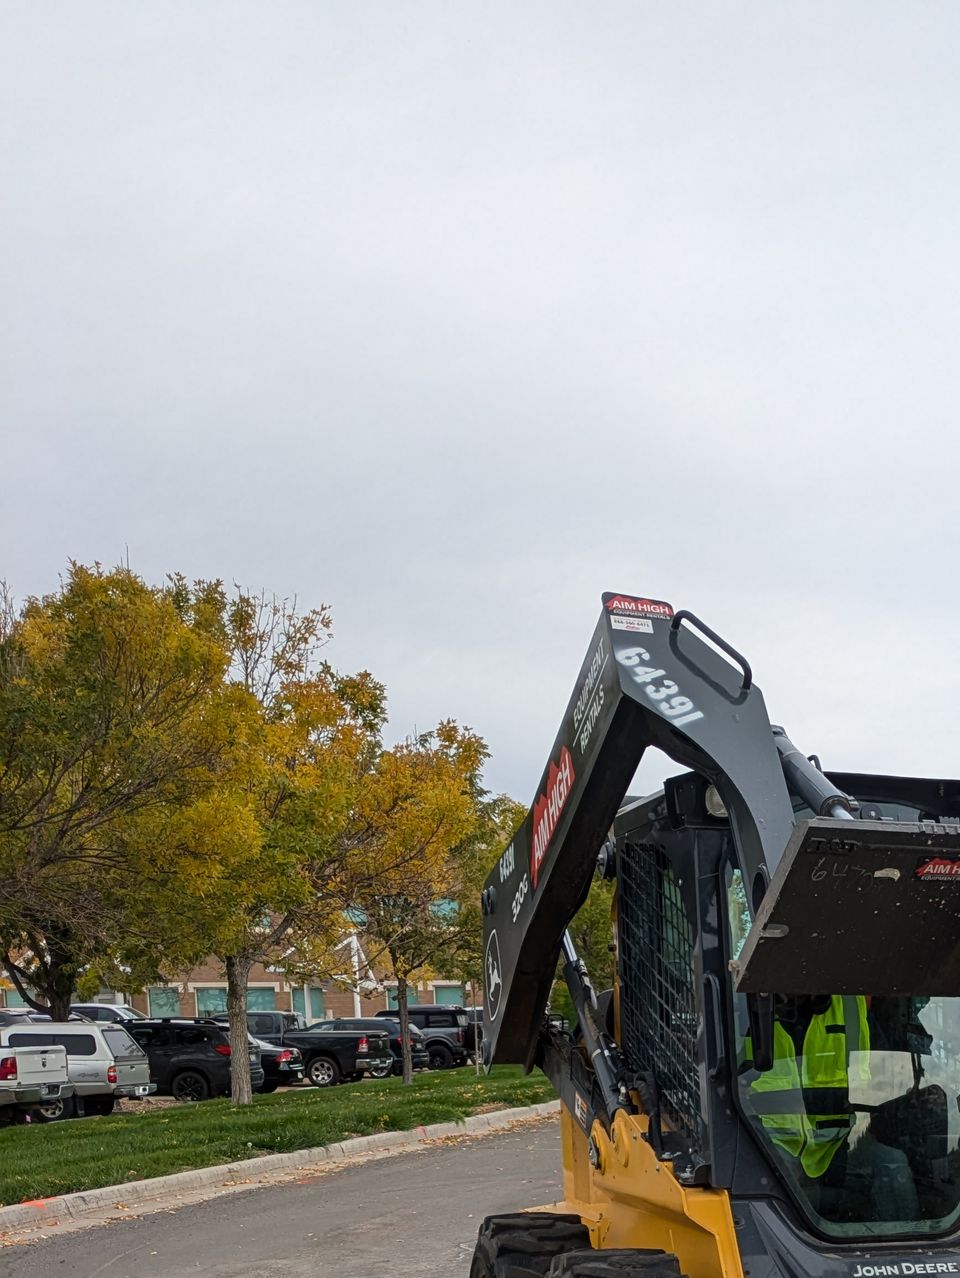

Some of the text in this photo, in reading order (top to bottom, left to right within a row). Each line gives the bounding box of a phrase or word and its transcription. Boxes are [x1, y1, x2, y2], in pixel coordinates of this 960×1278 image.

[613, 600, 669, 614] AIM HIGH
[573, 637, 604, 730] EQUIPMENT
[615, 647, 704, 727] 64391
[580, 684, 604, 754] RENTALS
[534, 751, 571, 870] AIM HIGH
[511, 872, 528, 923] 320G
[923, 864, 951, 874] AIM
[853, 1262, 959, 1277] JOHN DEERE
